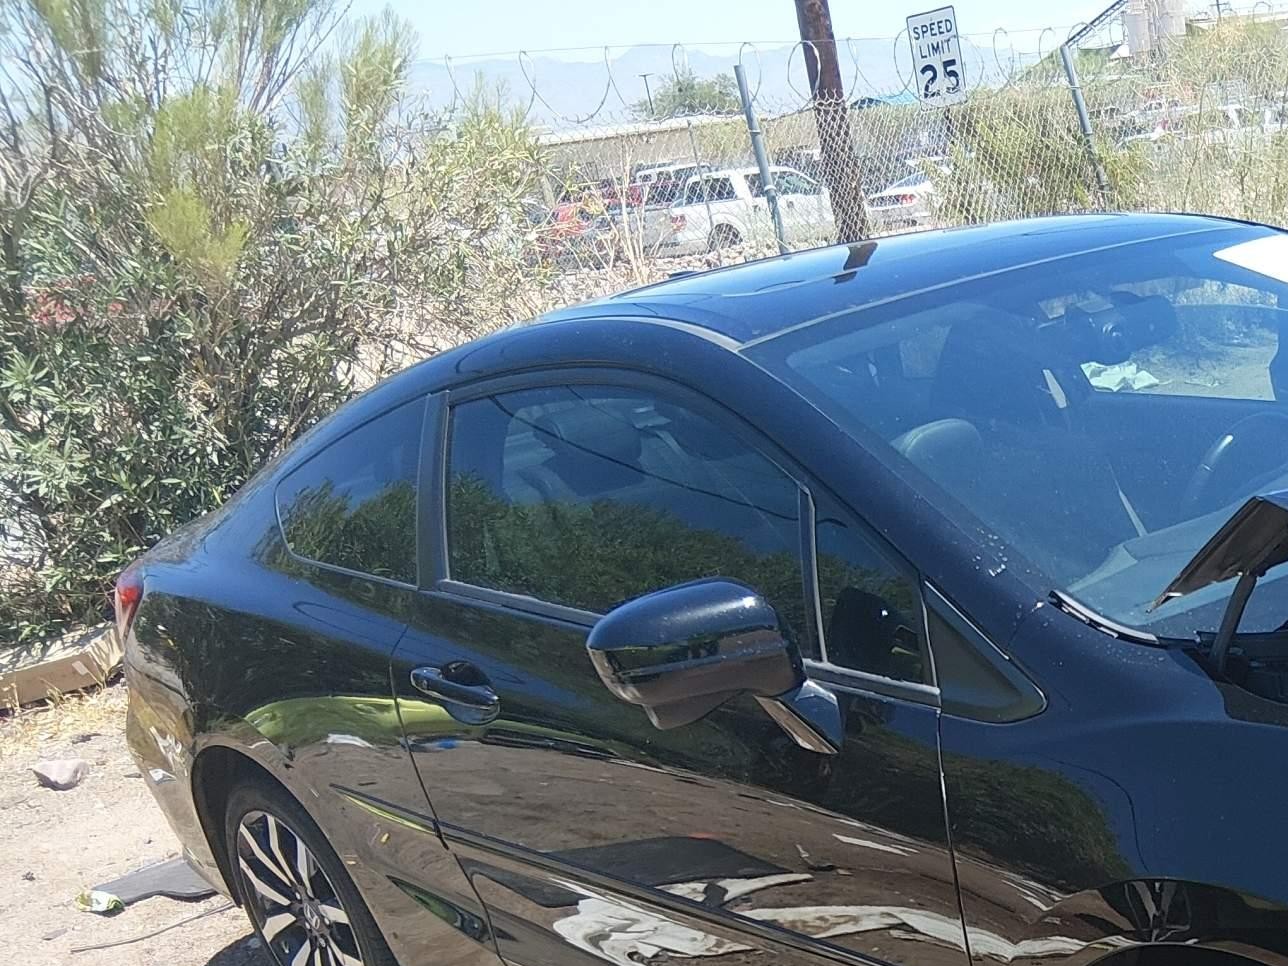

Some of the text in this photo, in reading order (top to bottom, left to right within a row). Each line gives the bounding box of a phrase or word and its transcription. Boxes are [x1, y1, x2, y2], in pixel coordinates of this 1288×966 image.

[912, 19, 953, 40] SPEED
[919, 39, 952, 59] LIMIT
[920, 59, 960, 98] 25
